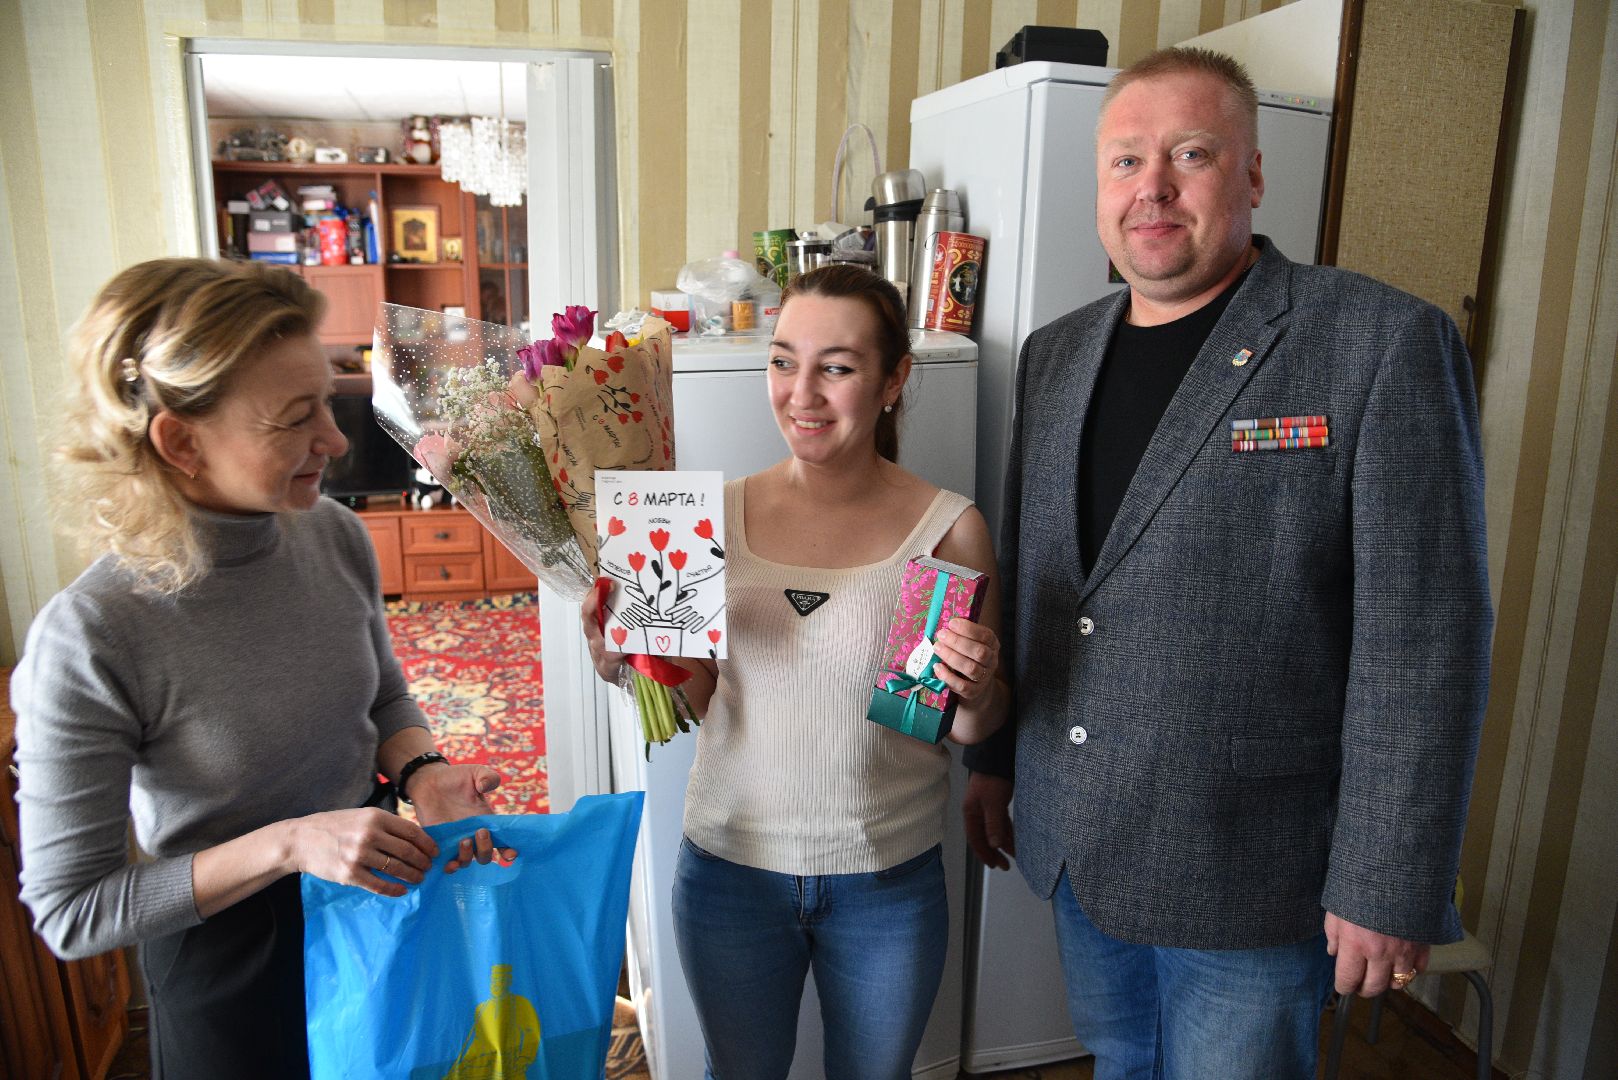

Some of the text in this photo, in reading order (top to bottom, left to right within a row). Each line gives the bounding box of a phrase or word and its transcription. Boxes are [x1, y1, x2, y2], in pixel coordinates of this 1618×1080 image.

[613, 491, 623, 505] С
[628, 491, 639, 507] 8
[643, 492, 696, 507] МАРТА
